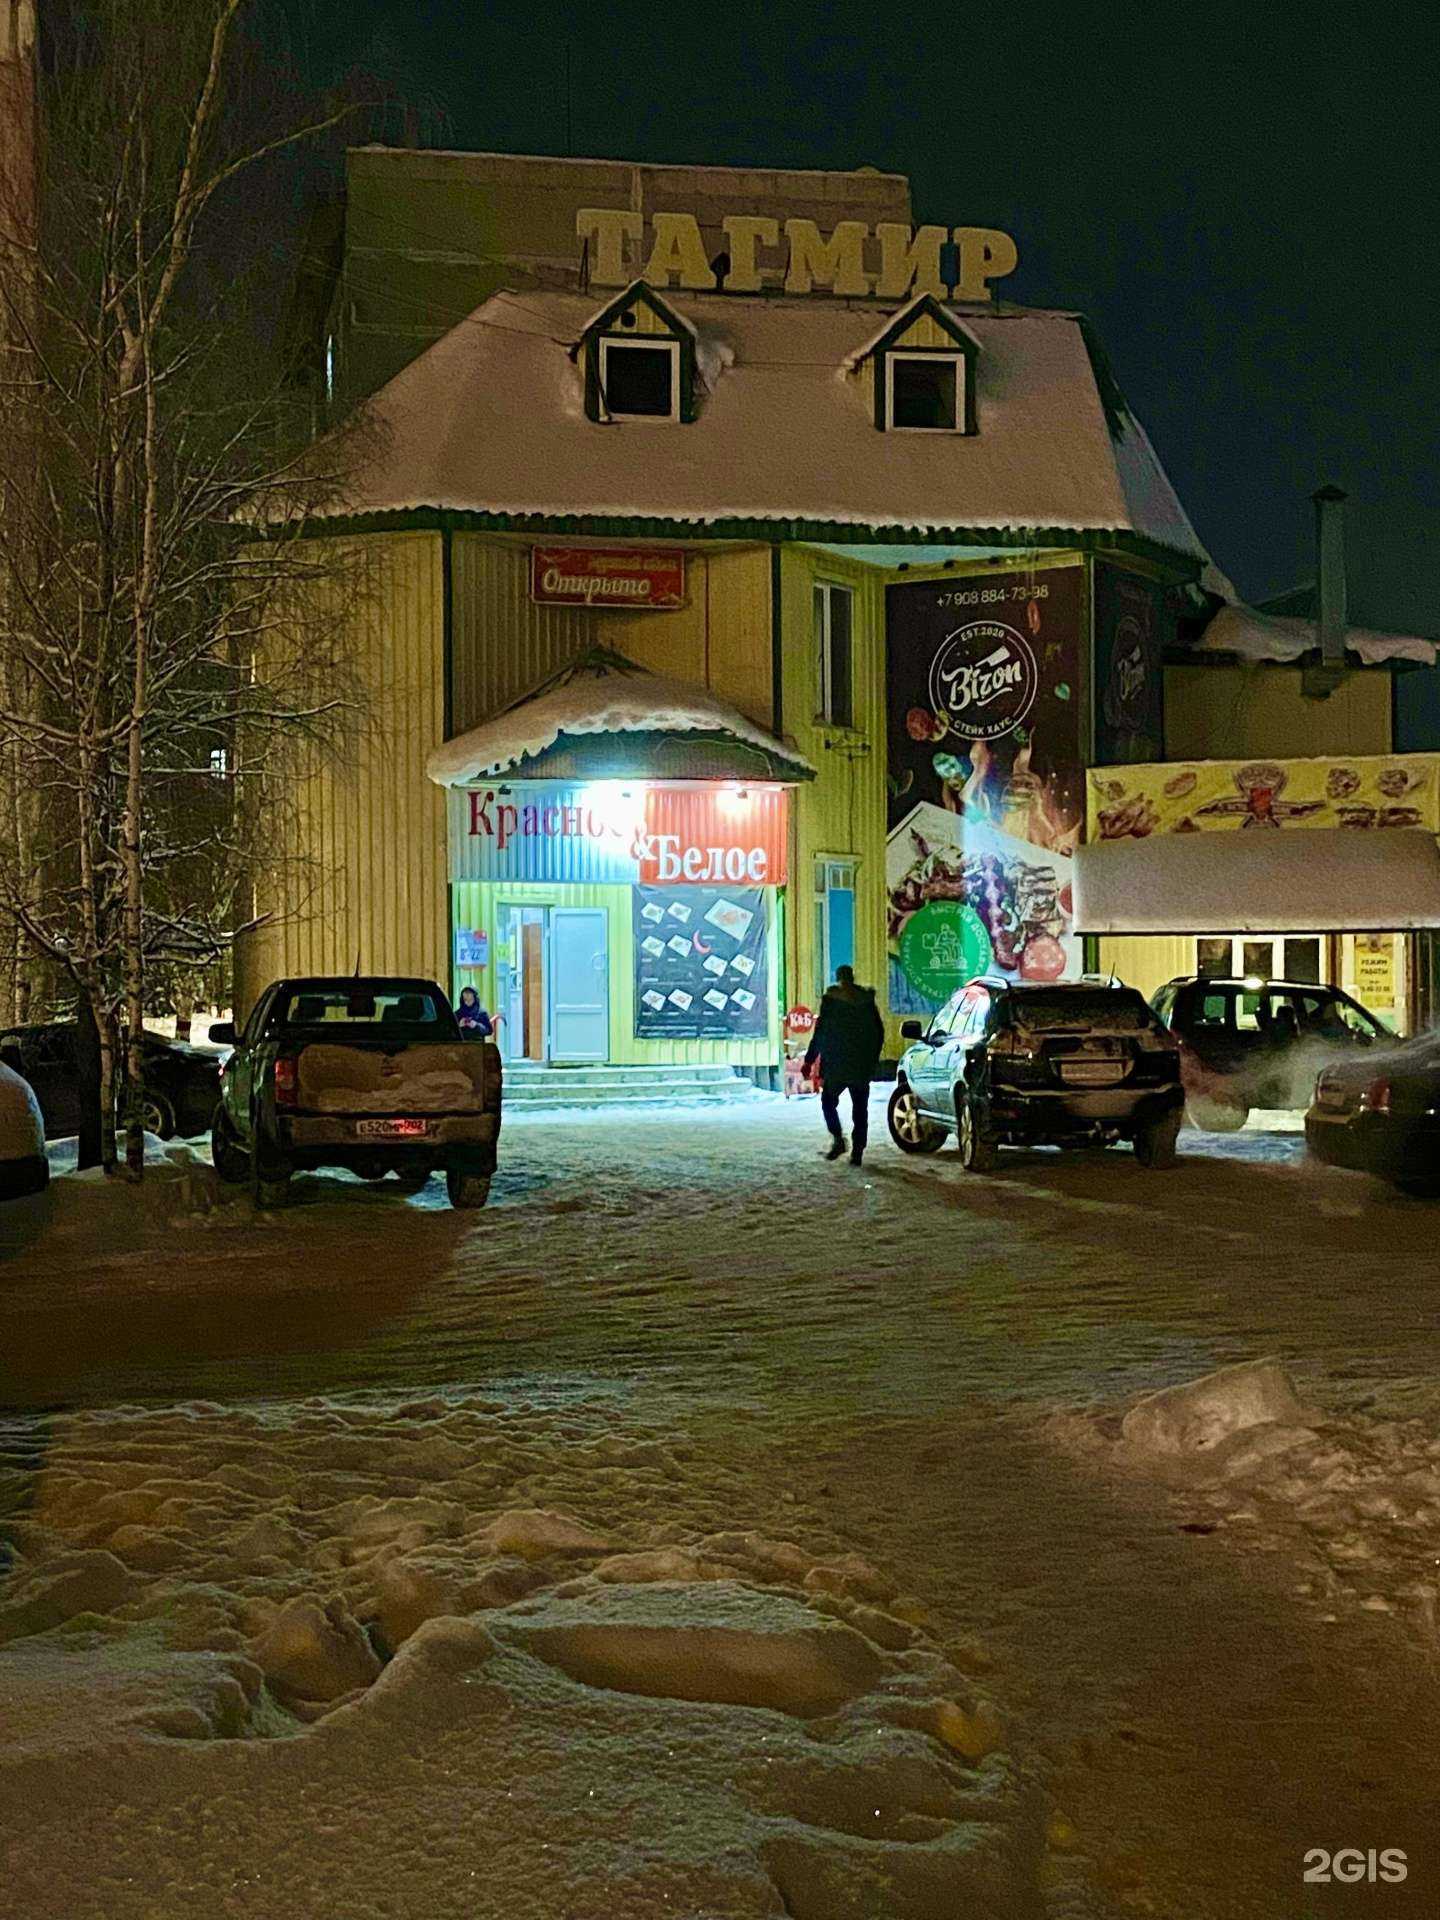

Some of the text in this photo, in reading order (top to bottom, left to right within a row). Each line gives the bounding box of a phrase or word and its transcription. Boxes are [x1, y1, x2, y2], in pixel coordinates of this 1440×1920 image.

[577, 209, 1017, 300] ТАГМИР
[542, 568, 651, 603] Открыто
[941, 660, 1022, 711] Bizon
[467, 791, 622, 849] Красно
[656, 834, 768, 881] Белое
